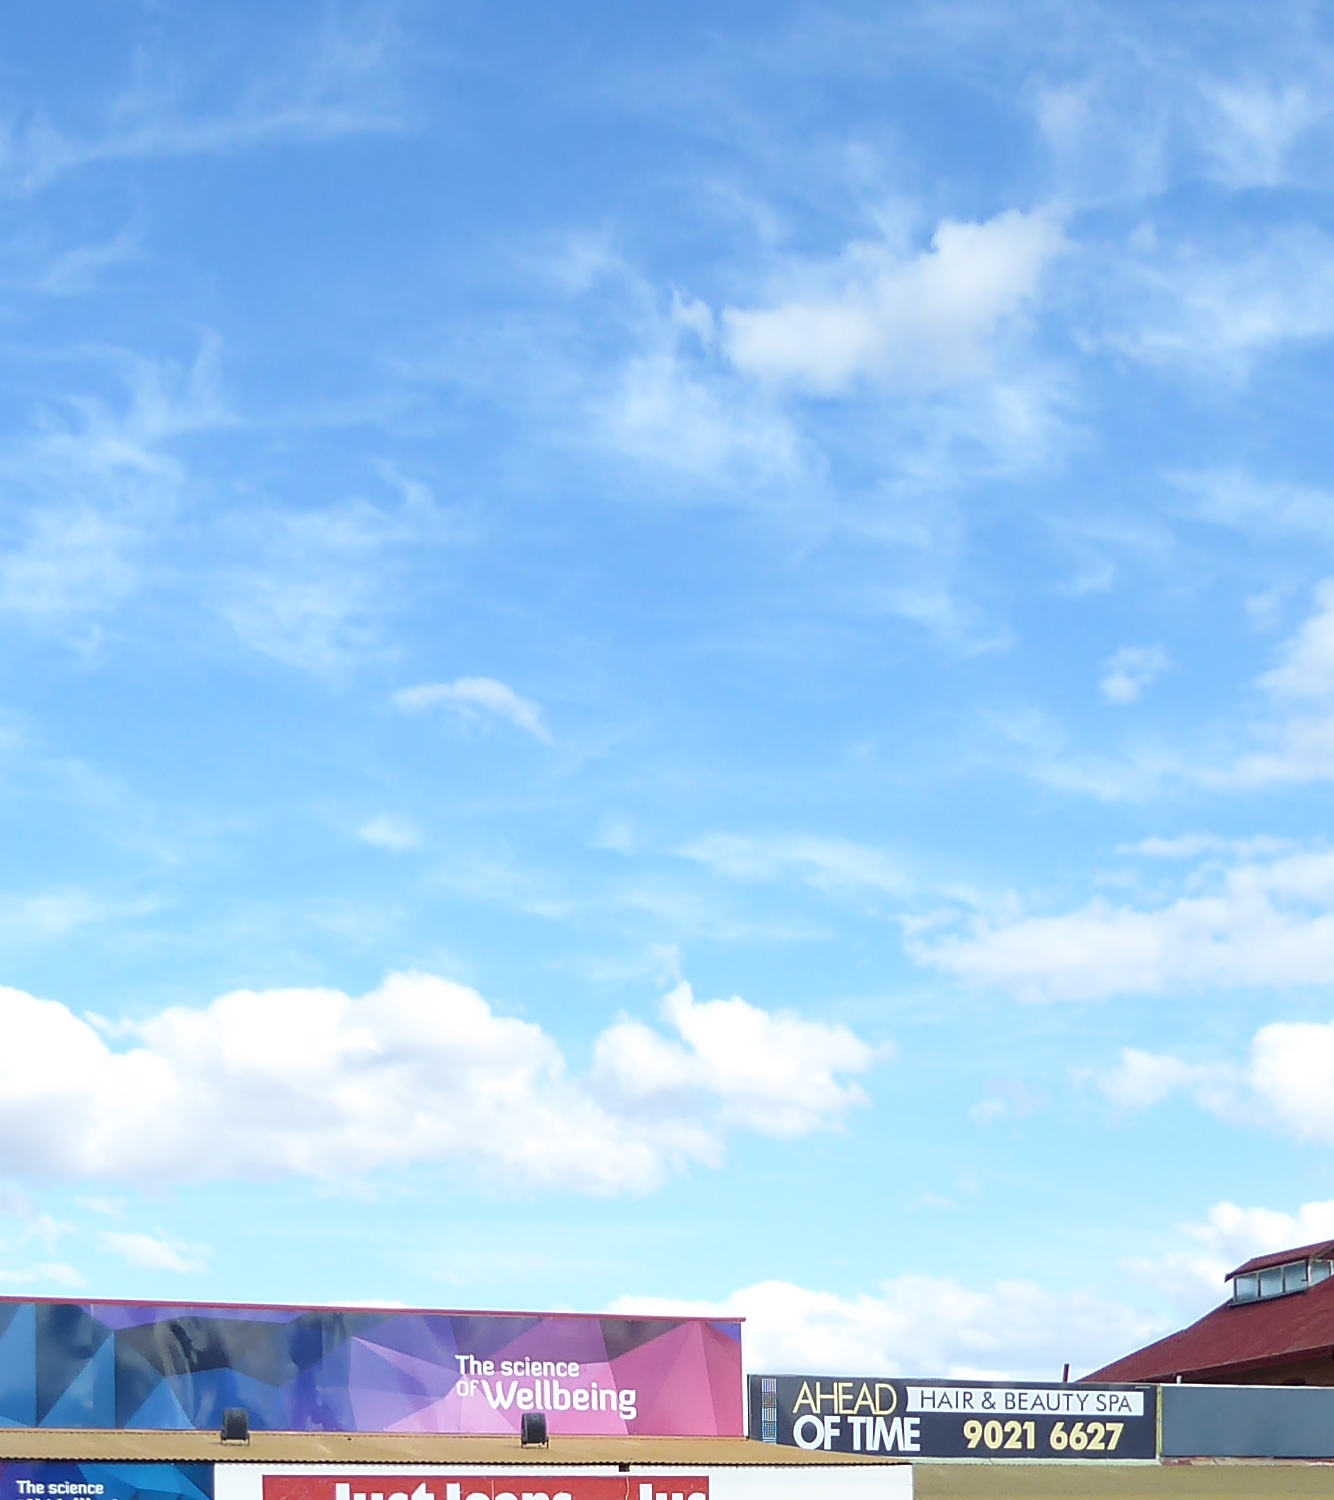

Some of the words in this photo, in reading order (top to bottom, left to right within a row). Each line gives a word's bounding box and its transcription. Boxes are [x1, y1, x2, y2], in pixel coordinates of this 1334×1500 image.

[454, 1354, 495, 1377] The
[500, 1356, 580, 1378] science
[481, 1379, 638, 1420] Wellbeing
[793, 1381, 898, 1416] AHEAD
[919, 1390, 974, 1410] HAIR
[980, 1391, 995, 1410] &
[1004, 1393, 1087, 1411] BEAUTY
[1095, 1395, 1133, 1413] SPA
[793, 1415, 843, 1451] OF
[846, 1416, 921, 1451] TIME
[963, 1419, 1037, 1450] 9021
[1049, 1421, 1125, 1451] 6627
[15, 1479, 45, 1495] The
[48, 1480, 105, 1495] science
